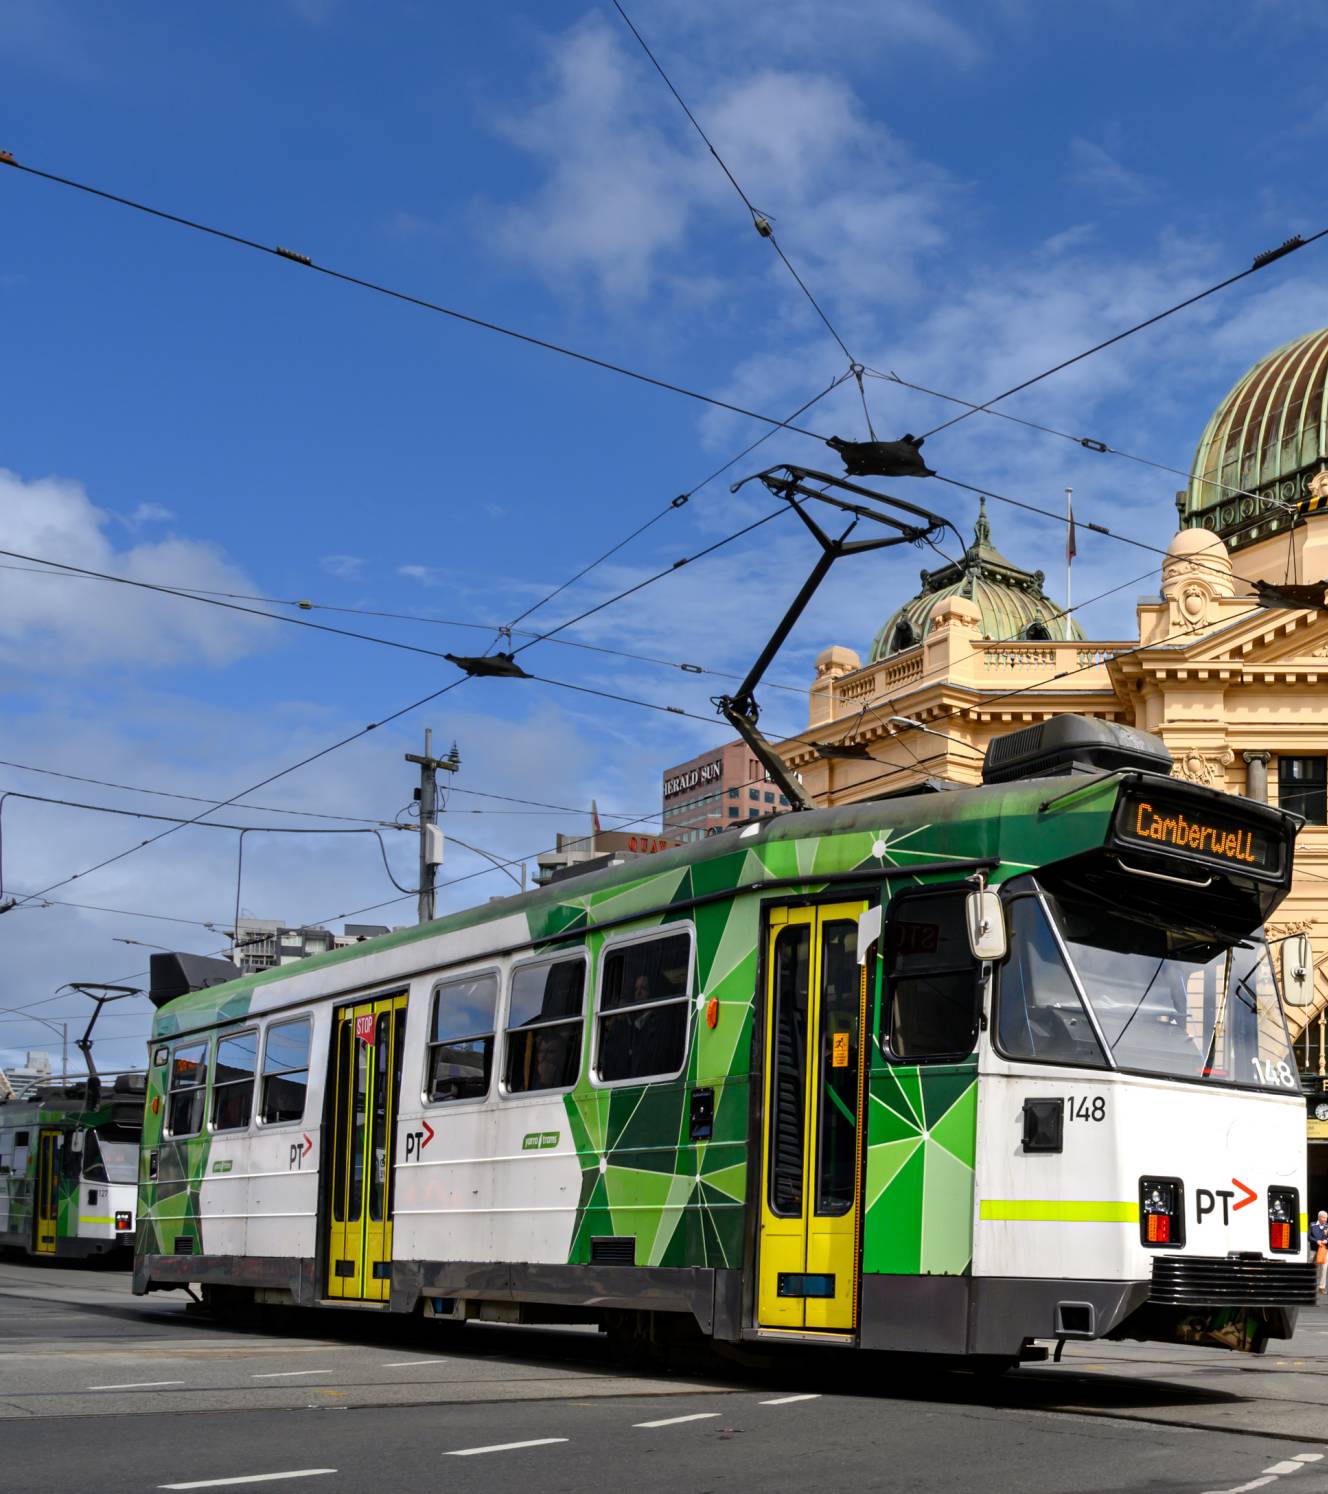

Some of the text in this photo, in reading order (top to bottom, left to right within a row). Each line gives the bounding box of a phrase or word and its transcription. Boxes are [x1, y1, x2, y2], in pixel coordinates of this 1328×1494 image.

[701, 761, 721, 782] SUN
[1136, 803, 1256, 862] Camberwell
[356, 1015, 373, 1035] STOP
[1251, 1057, 1295, 1087] 148
[1067, 1096, 1106, 1122] 148
